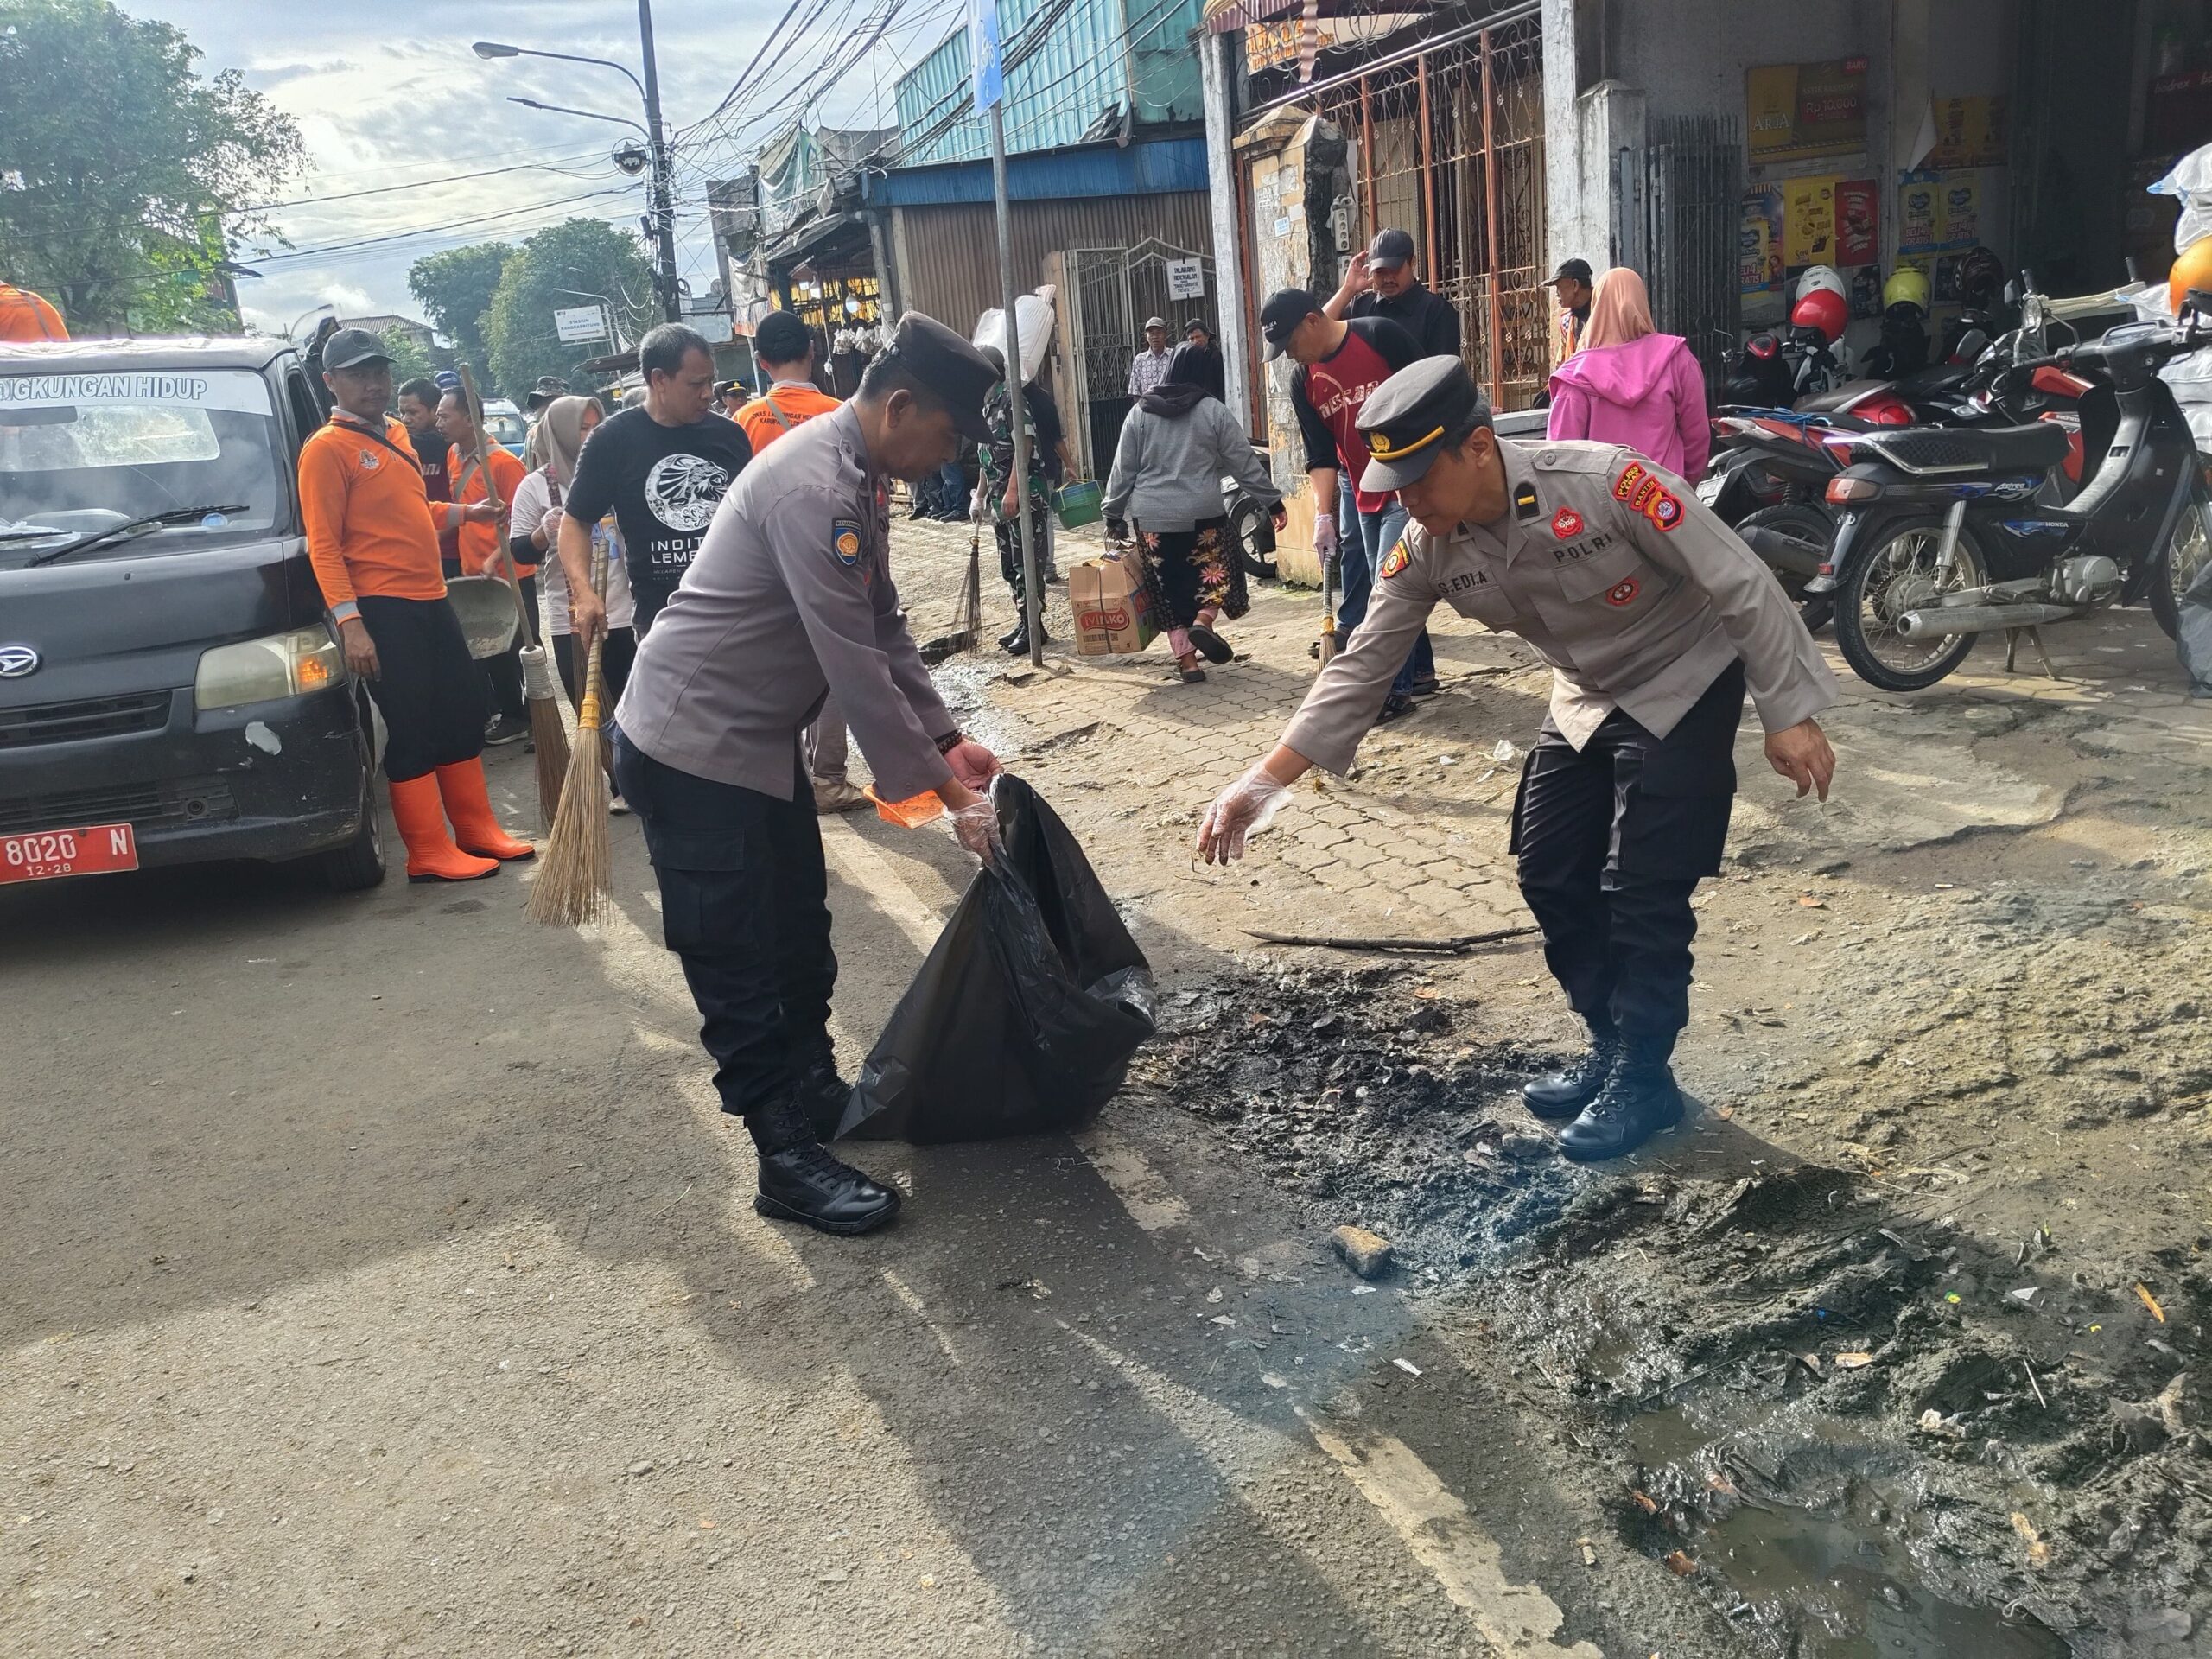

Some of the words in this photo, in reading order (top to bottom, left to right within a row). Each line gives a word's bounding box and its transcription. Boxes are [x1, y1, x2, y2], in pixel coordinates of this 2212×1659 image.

[1846, 60, 1866, 70] BARU
[1806, 102, 1821, 116] Rp
[1822, 97, 1857, 111] 10.000
[1752, 113, 1790, 132] ARJA
[136, 377, 207, 400] HIDUP
[1618, 466, 1639, 496] POLRES
[1635, 480, 1655, 506] BANTEN
[1553, 532, 1613, 563] POLRI
[1084, 614, 1126, 627] MILKO
[5, 834, 77, 866] 8020
[110, 829, 128, 855] N
